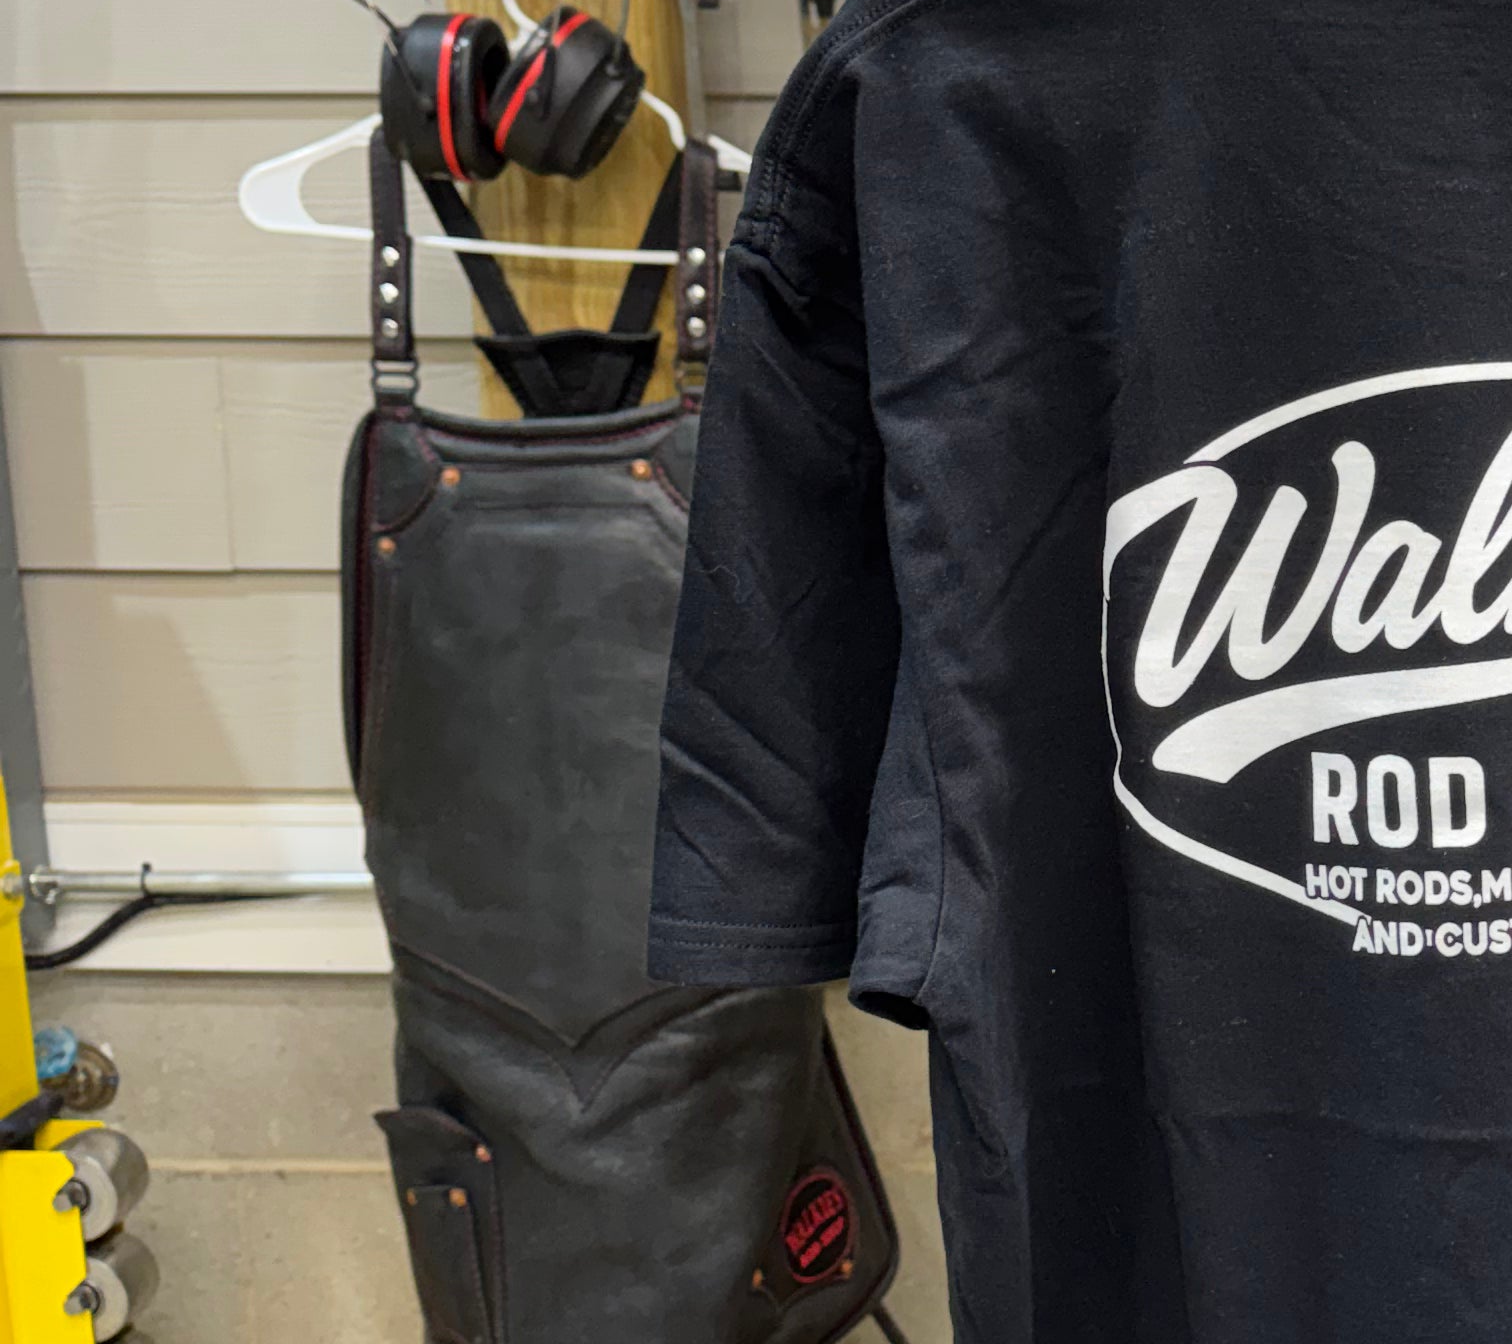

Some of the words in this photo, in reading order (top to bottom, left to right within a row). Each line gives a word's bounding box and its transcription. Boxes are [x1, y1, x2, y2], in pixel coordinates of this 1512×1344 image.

[1309, 751, 1487, 849] ROD
[1304, 862, 1368, 902] HOT
[1352, 918, 1424, 956] AND
